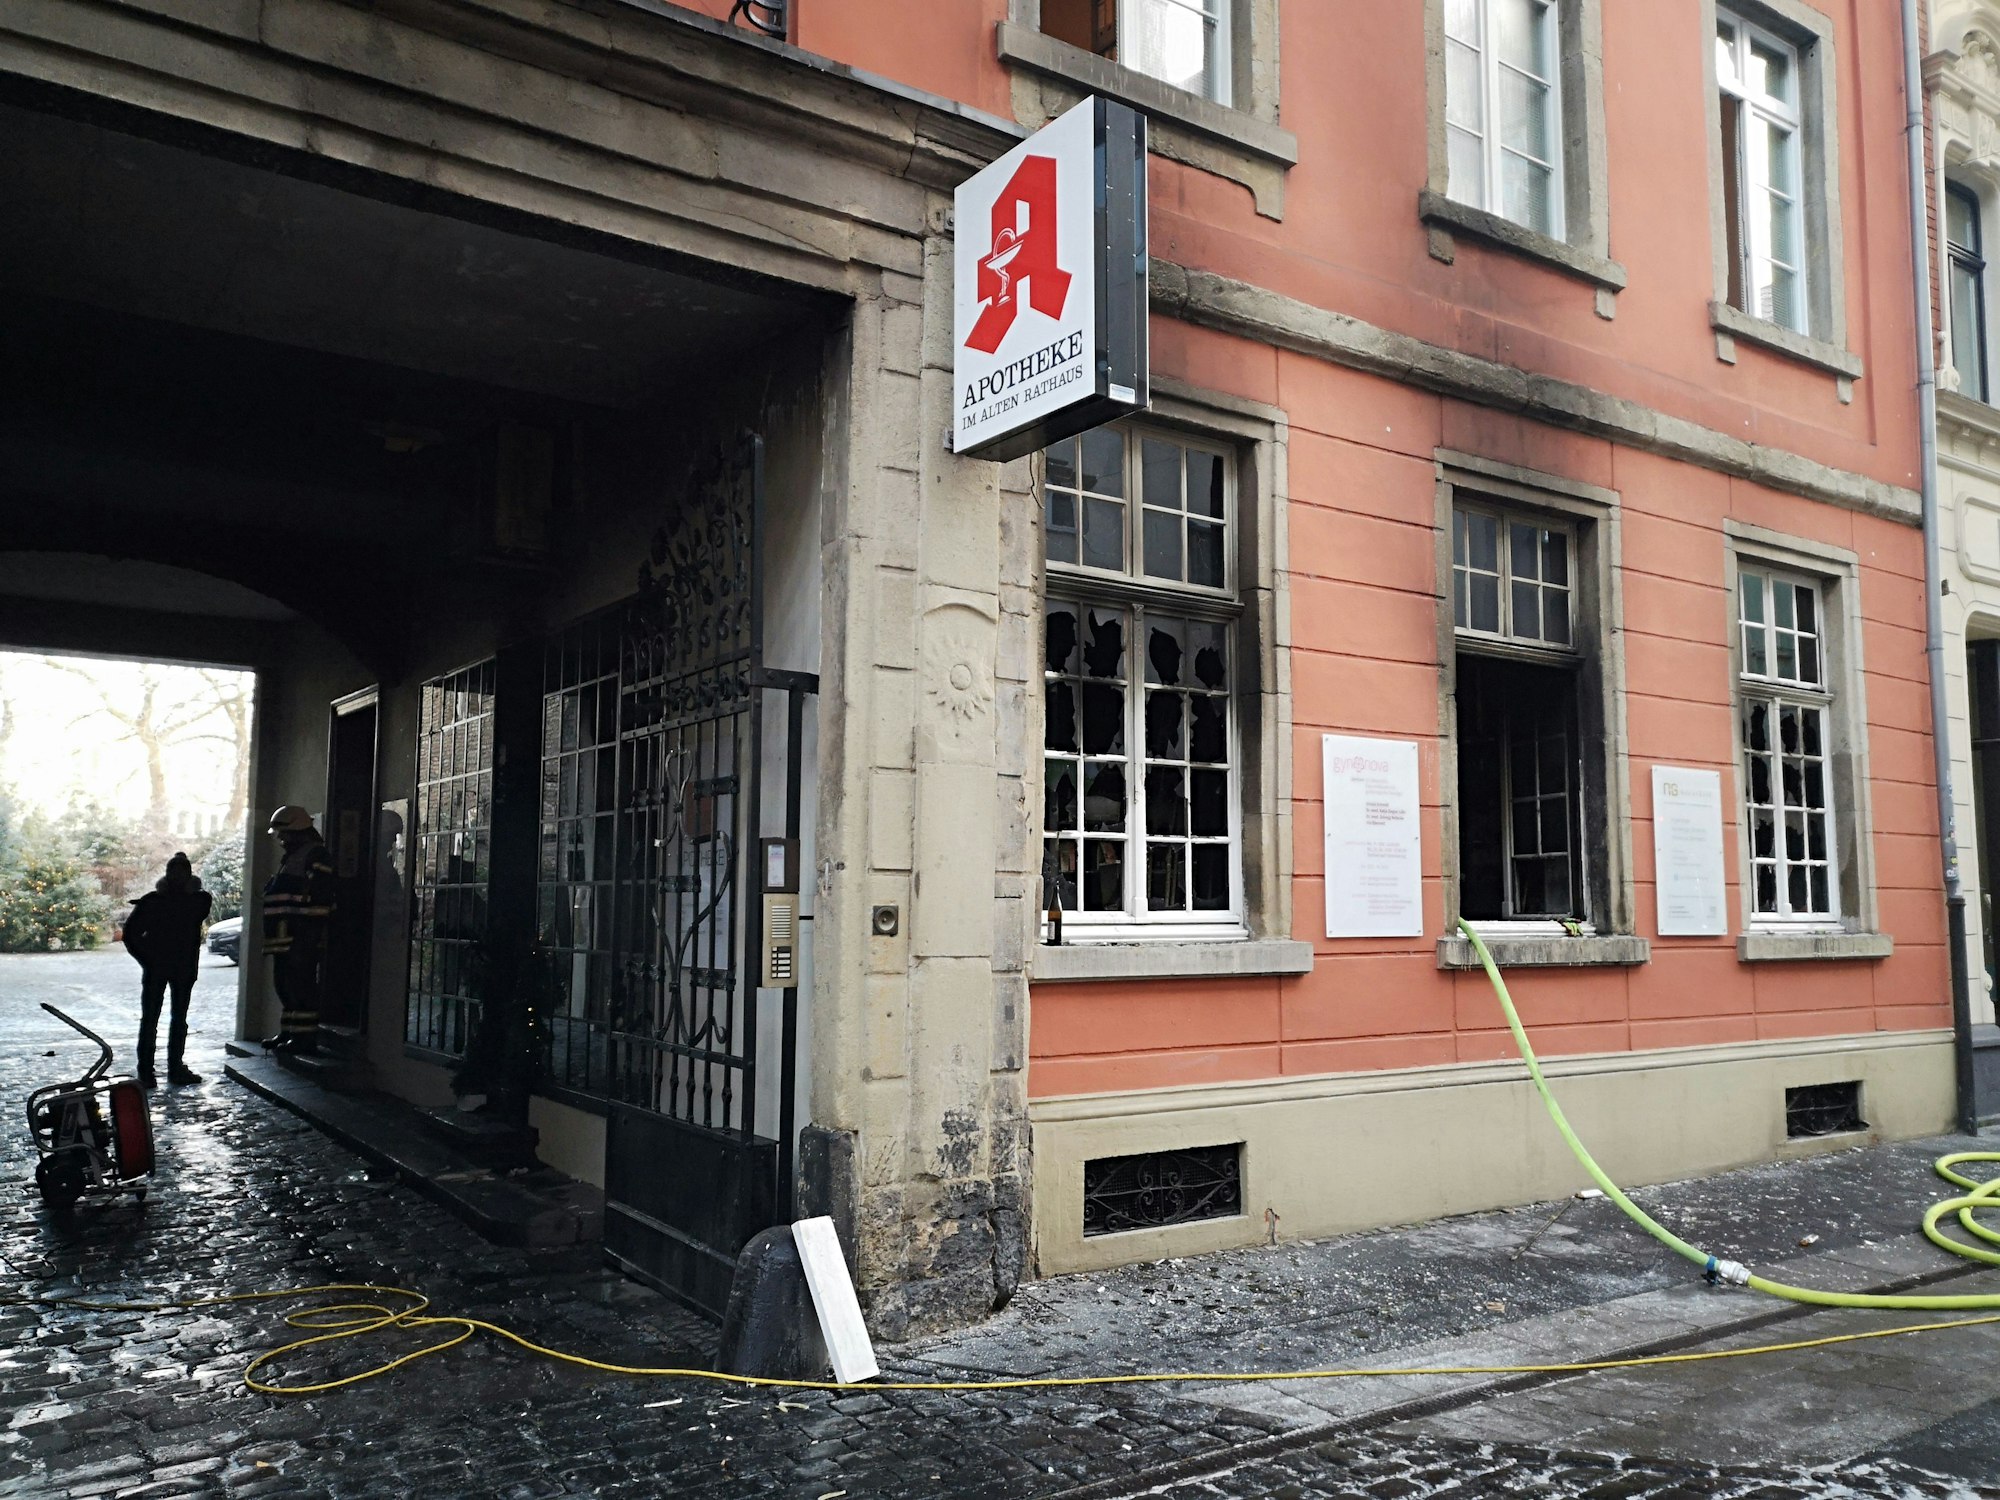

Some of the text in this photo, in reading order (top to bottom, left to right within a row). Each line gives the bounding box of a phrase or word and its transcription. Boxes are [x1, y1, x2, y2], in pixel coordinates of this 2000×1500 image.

[962, 329, 1082, 409] APOTHEKE
[962, 364, 1083, 430] IM ALTEN RATHAUS
